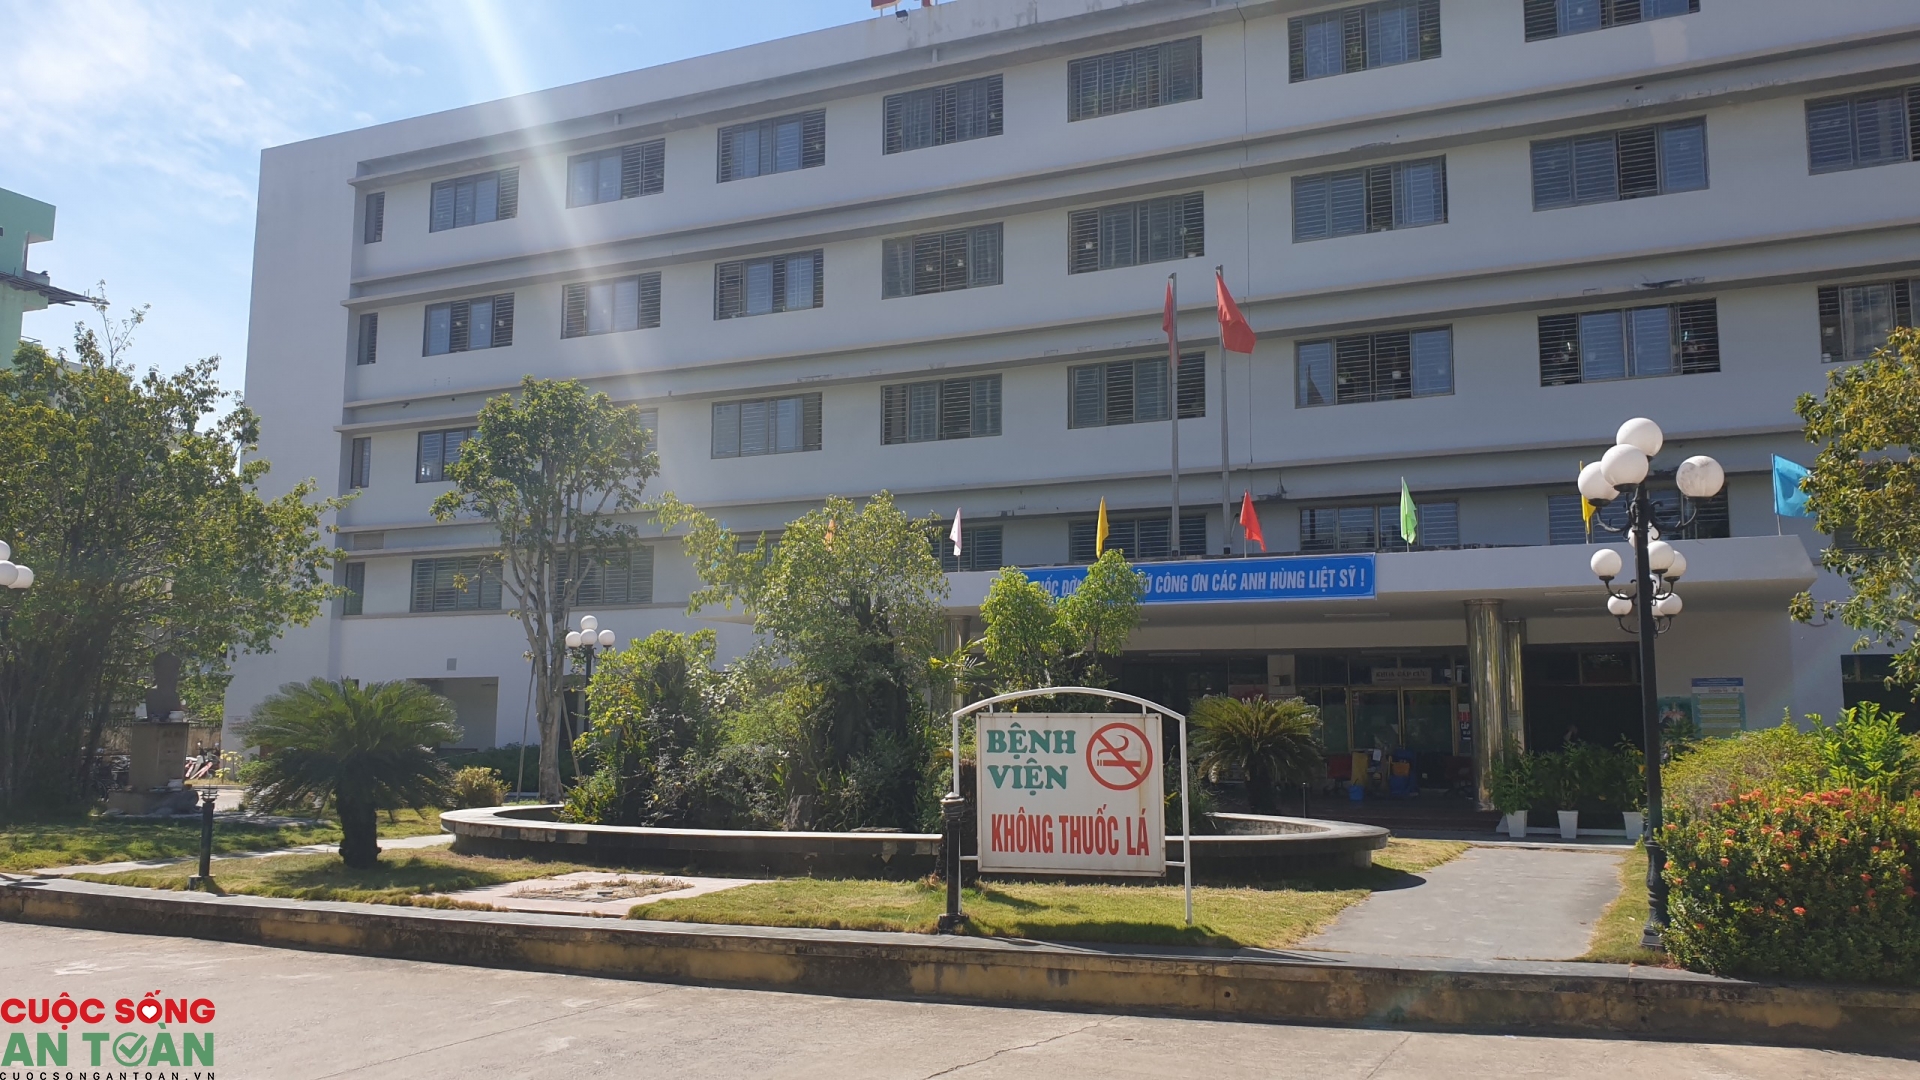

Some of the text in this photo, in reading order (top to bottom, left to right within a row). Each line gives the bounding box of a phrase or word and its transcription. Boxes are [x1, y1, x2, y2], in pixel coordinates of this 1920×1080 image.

[1155, 572, 1188, 594] CÔNG
[1191, 573, 1209, 593] ƠN
[1212, 570, 1237, 591] CÁC
[1240, 571, 1267, 591] ANH
[1269, 567, 1305, 590] HÙNG
[1309, 566, 1336, 592] LIỆT
[1339, 565, 1356, 588] SỸ
[986, 722, 1076, 759] BỆNH
[987, 757, 1069, 796] VIỆN
[991, 804, 1150, 856] KHÔNG THUỐC LÁ
